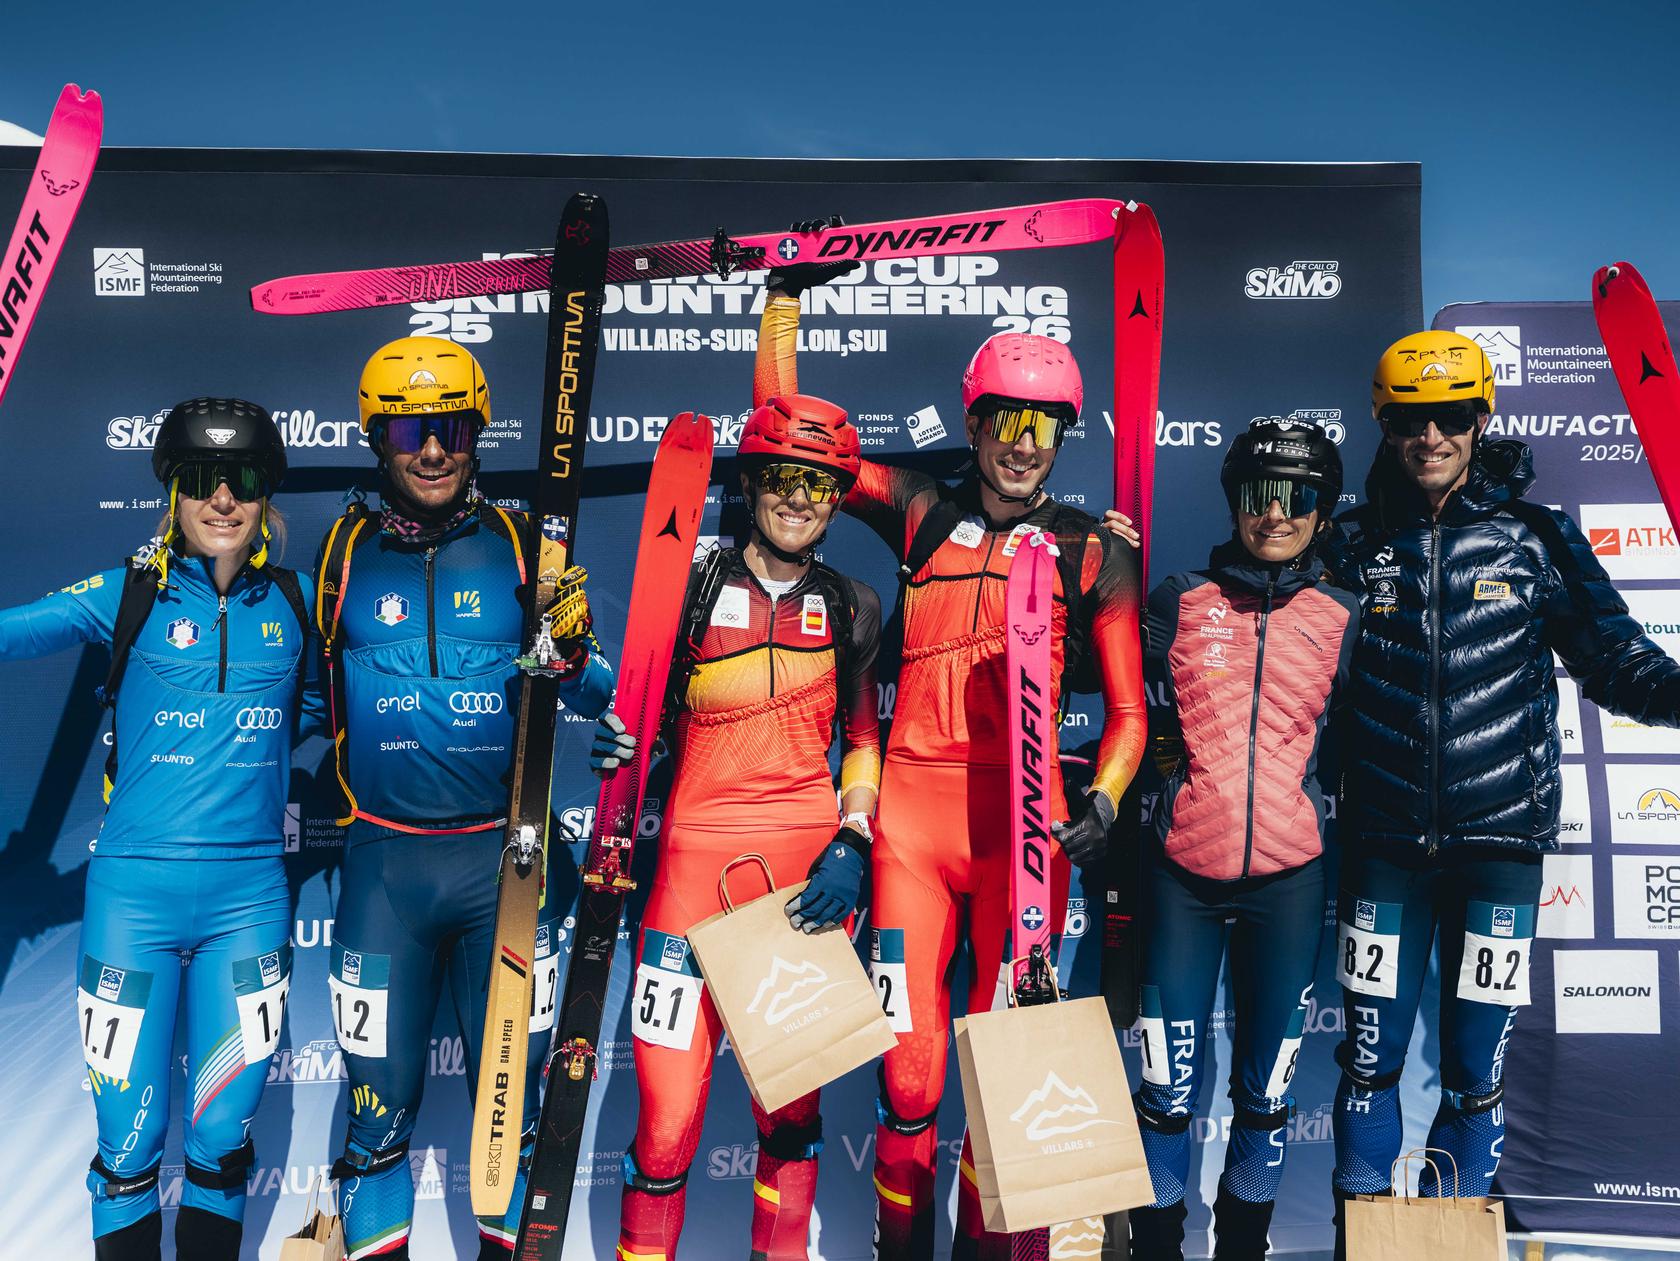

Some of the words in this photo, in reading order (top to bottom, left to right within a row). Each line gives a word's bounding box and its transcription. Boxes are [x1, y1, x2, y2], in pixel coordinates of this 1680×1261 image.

[816, 220, 1007, 258] DYNAFIT
[150, 263, 207, 272] International
[208, 263, 223, 272] Ski
[874, 255, 999, 285] CUP
[1294, 263, 1309, 271] THE
[1309, 263, 1326, 271] CALL
[1326, 263, 1337, 271] OF
[150, 273, 223, 284] Mountaineering
[403, 267, 467, 301] DNA
[477, 273, 528, 294] SPRINT
[1246, 267, 1340, 298] SkiMo
[99, 278, 141, 292] ISMF
[150, 283, 199, 292] Federation
[408, 313, 493, 344] 25
[992, 316, 1072, 345] 26
[603, 328, 887, 358] VILLARS-SURLON,SUI
[556, 291, 586, 435] SPORTIVA
[1527, 358, 1612, 370] Mountaineeri
[1528, 372, 1596, 384] Federation
[409, 383, 449, 391] SPORTIVA
[382, 403, 398, 413] LA
[401, 399, 469, 413] SPORTIVA
[858, 414, 894, 422] FONDS
[1296, 411, 1310, 419] THE
[1310, 411, 1328, 419] CALL
[1328, 411, 1340, 419] OF
[509, 419, 522, 428] Ski
[866, 426, 900, 434] SPORT
[918, 424, 943, 437] LOTERIE
[860, 438, 885, 446] DOIS
[915, 429, 945, 445] ROMANDE
[1580, 444, 1648, 464] 2025/
[1625, 528, 1675, 547] ATK
[1367, 566, 1400, 575] FRANCE
[1478, 583, 1507, 594] ARMÉE
[1200, 626, 1234, 635] FRANCE
[376, 691, 421, 713] enel
[154, 708, 205, 729] enel
[452, 718, 477, 727] Audi
[233, 734, 257, 744] Audi
[380, 741, 420, 751] SUUNTO
[150, 754, 194, 765] SUUNTO
[1020, 664, 1050, 885] DYNAFIT
[1617, 811, 1634, 820] LA
[1357, 911, 1373, 921] ISMF
[1494, 919, 1512, 927] ISMF
[664, 949, 683, 960] ISMF
[1344, 936, 1384, 983] 8.2
[263, 964, 278, 976] ISMF
[344, 964, 358, 974] ISMF
[1475, 946, 1521, 991] 8.2
[100, 979, 119, 990] ISMF
[1562, 985, 1651, 997] SALOMON
[640, 978, 684, 1031] 5.1
[257, 990, 286, 1043] 1.1
[335, 992, 370, 1043] 1.2
[781, 1008, 823, 1034] VILLARS
[84, 1006, 120, 1060] 1.1
[502, 1019, 514, 1042] SPEED
[311, 1043, 326, 1051] THE
[500, 1044, 511, 1064] GARA
[1040, 1138, 1084, 1155] VILLARS
[588, 1150, 625, 1160] FONDS
[573, 1177, 616, 1187] AUDOIS
[528, 1222, 559, 1231] ATOMIC
